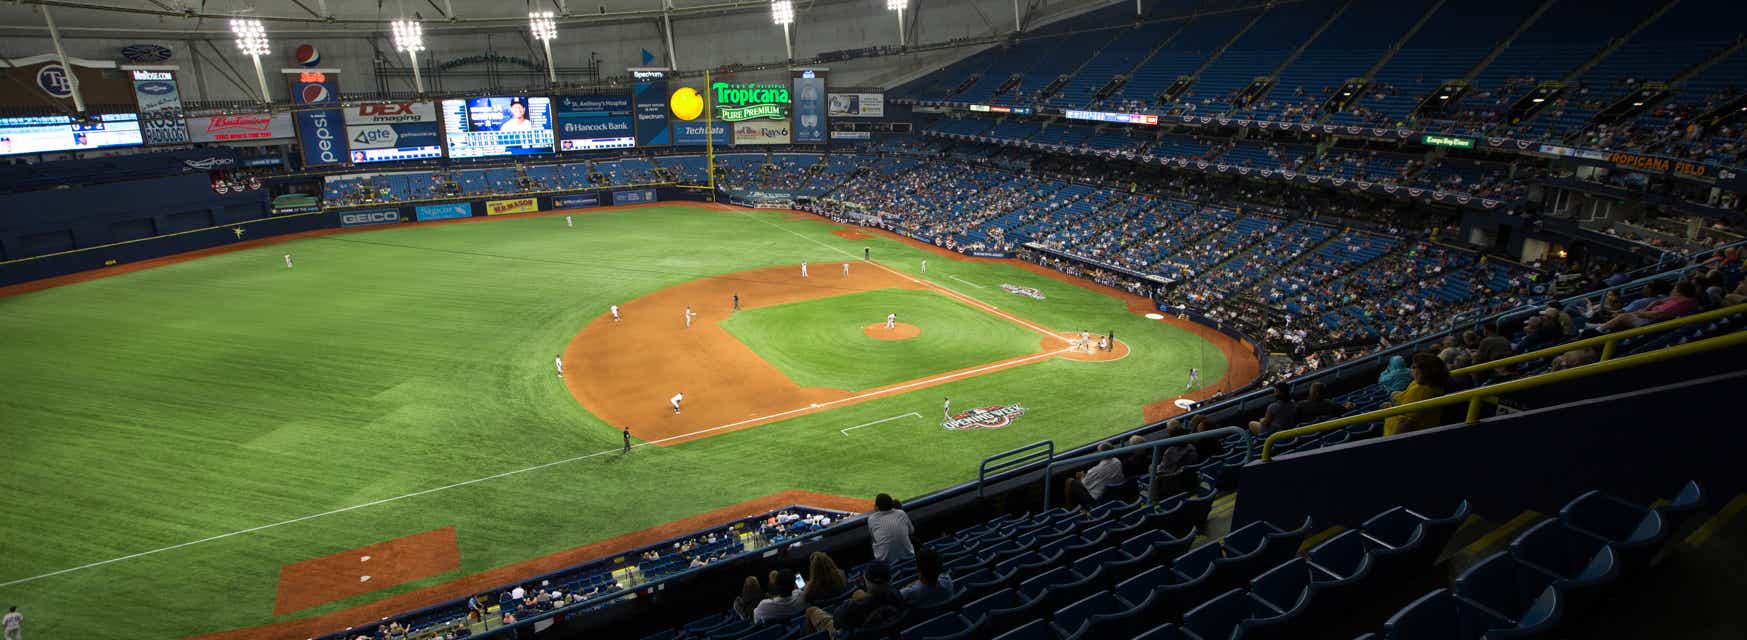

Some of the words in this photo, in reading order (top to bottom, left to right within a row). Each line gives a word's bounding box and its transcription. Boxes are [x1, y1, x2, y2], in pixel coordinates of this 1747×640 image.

[634, 71, 664, 79] Spectrum
[713, 82, 789, 105] Tropicana
[360, 103, 414, 116] DEX
[721, 110, 742, 122] PURE
[743, 106, 780, 119] PREMIUM
[575, 123, 608, 132] Hancock
[608, 122, 628, 130] Bank
[686, 127, 704, 135] Tech
[146, 128, 188, 144] RADIOLOGY
[310, 113, 338, 163] pepsi
[367, 128, 390, 141] gte
[1606, 152, 1672, 171] TROPICANA
[1674, 160, 1707, 178] FIELD
[343, 211, 398, 224] GEICO
